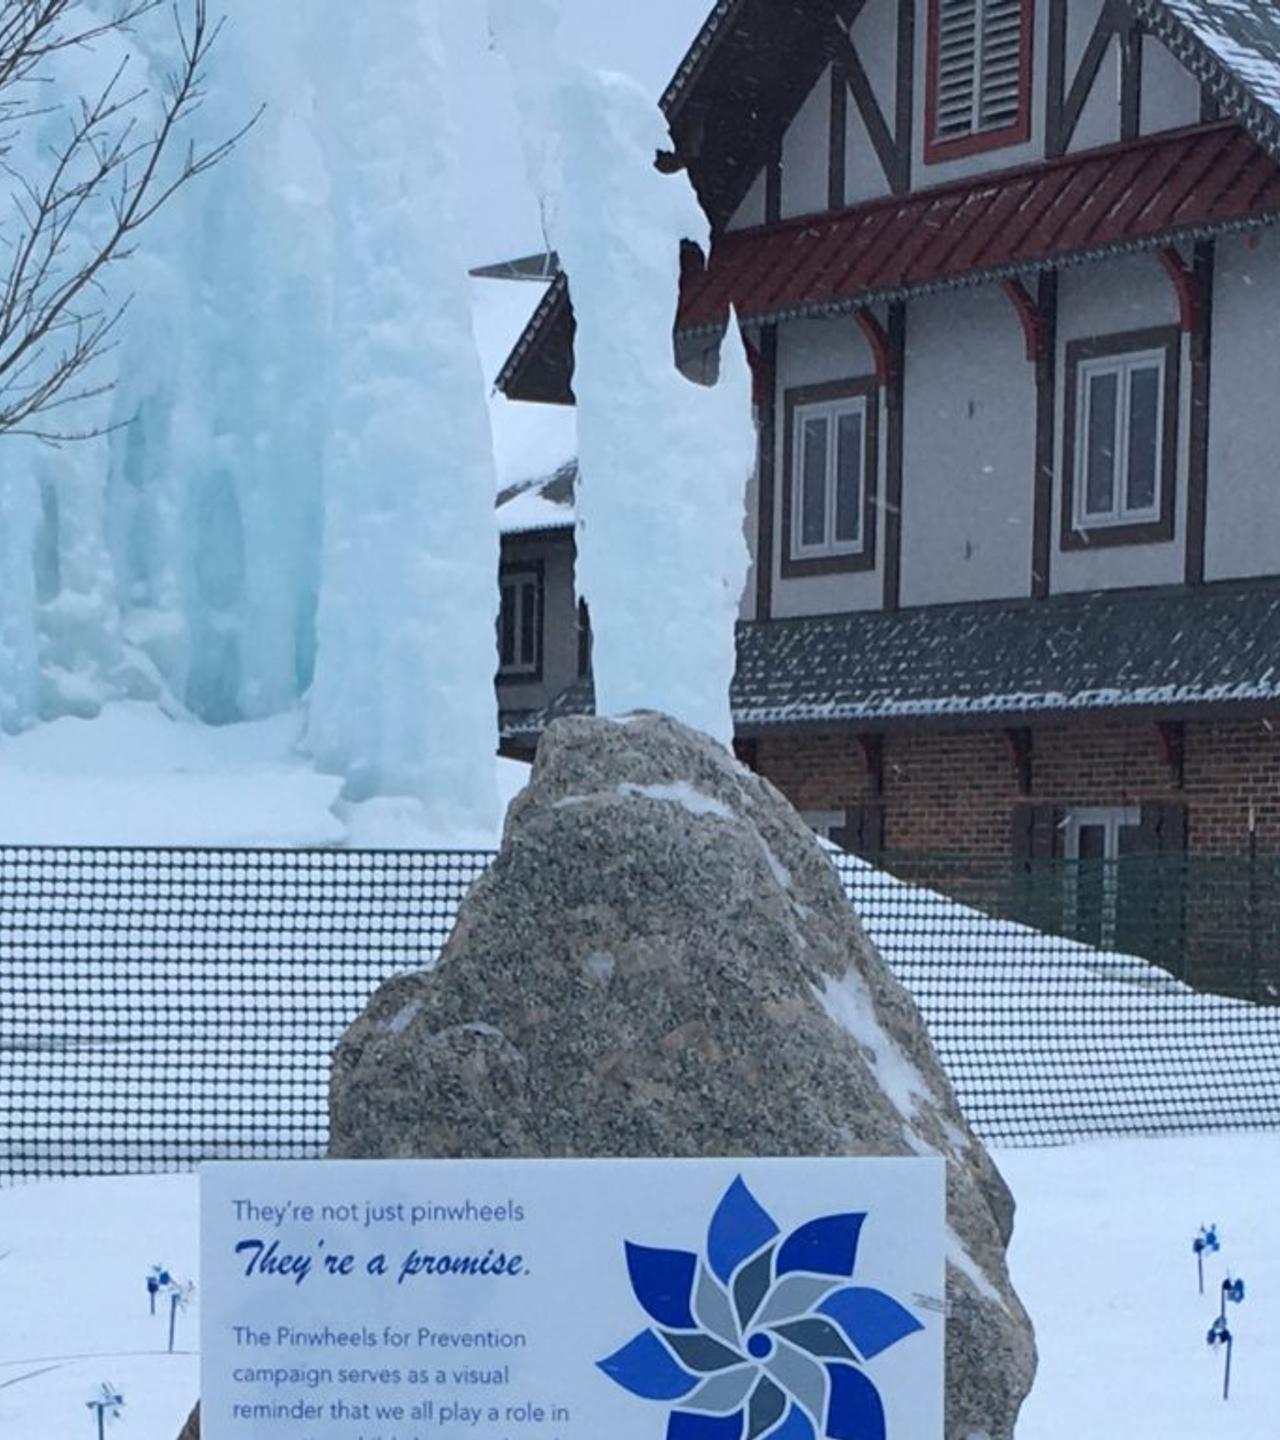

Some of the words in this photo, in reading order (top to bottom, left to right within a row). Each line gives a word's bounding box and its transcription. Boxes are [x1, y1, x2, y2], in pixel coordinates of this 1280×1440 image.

[232, 1199, 314, 1227] They're
[321, 1202, 359, 1222] not
[364, 1200, 405, 1227] just
[410, 1199, 525, 1227] pinwheels
[234, 1238, 355, 1287] They're
[365, 1252, 389, 1276] a
[397, 1248, 532, 1286] promise.
[233, 1326, 272, 1347] The
[277, 1326, 377, 1347] Pinwheels
[383, 1327, 411, 1348] for
[417, 1327, 526, 1348] Prevention
[232, 1364, 333, 1389] campaign
[338, 1369, 402, 1385] serves
[407, 1370, 429, 1384] as
[435, 1370, 447, 1384] a
[452, 1364, 509, 1385] visual
[232, 1398, 324, 1421] reminder
[329, 1399, 370, 1421] that
[375, 1406, 405, 1421] we
[410, 1400, 433, 1421] all
[439, 1401, 482, 1426] play
[487, 1407, 500, 1422] a
[505, 1402, 545, 1423] role
[551, 1403, 569, 1423] in
